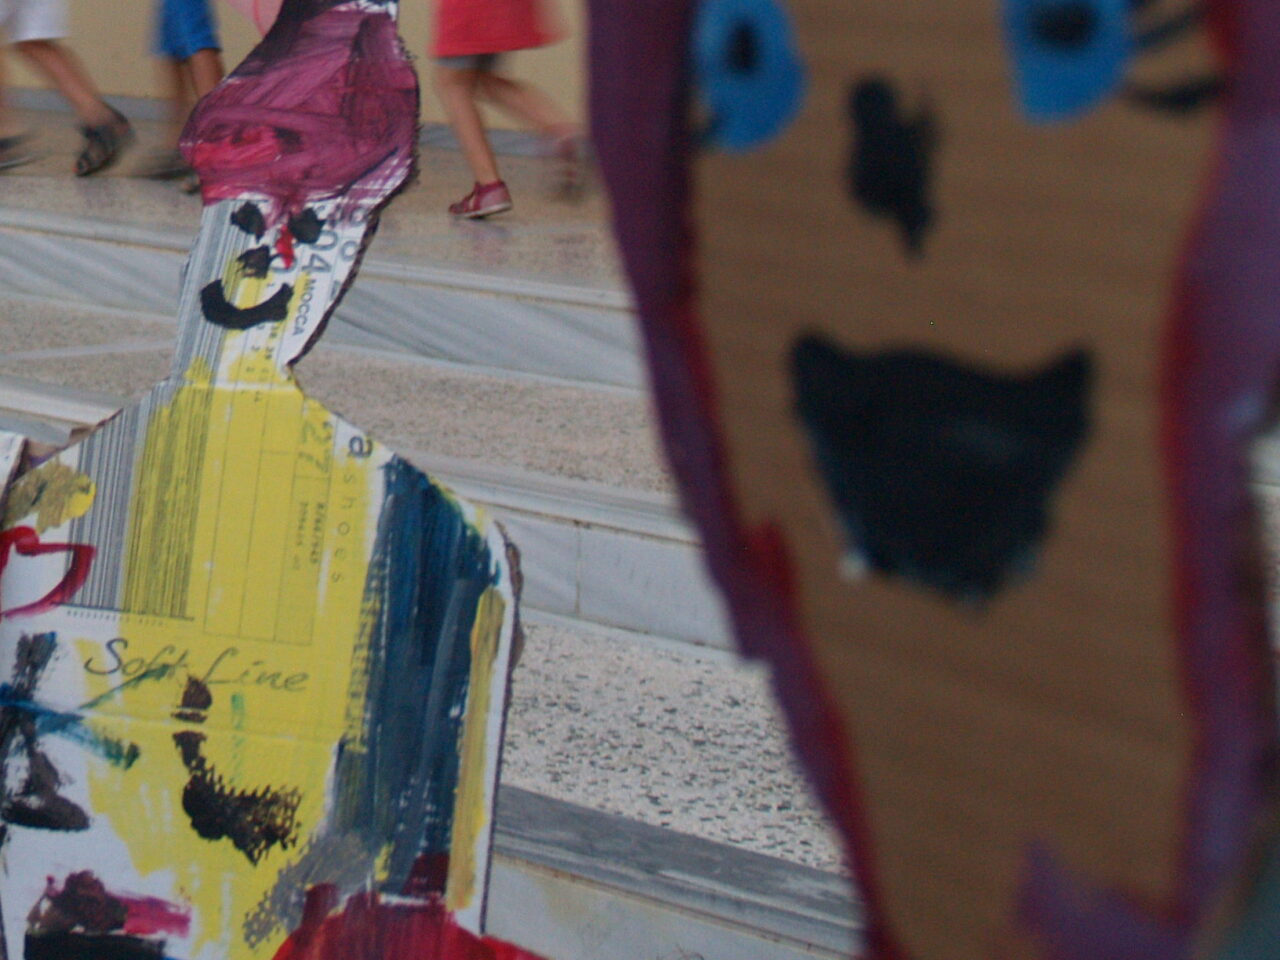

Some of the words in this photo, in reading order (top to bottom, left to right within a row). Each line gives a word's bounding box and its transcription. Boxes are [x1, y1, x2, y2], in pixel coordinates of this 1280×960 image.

[292, 279, 316, 336] MOCCA
[331, 473, 356, 583] shoes
[83, 637, 189, 682] Soft
[202, 646, 310, 691] Line
